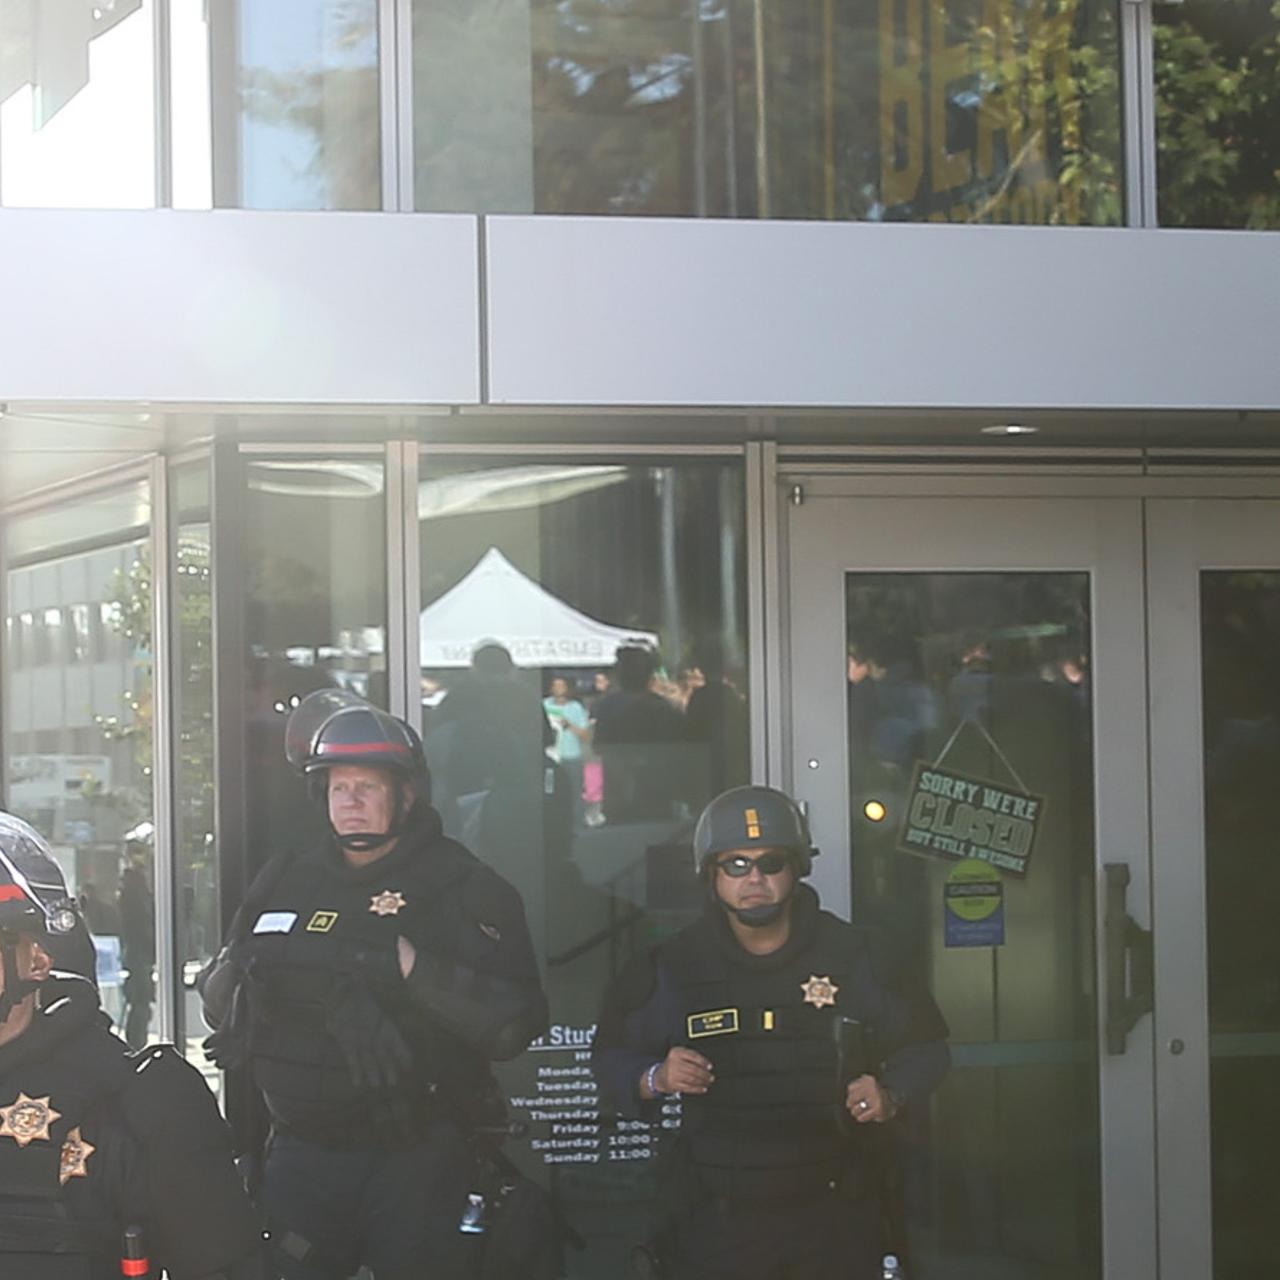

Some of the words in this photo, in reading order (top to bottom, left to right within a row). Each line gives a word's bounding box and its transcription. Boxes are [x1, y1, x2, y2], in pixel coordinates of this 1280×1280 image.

[919, 771, 980, 803] SORRY
[910, 791, 1035, 857] CLOSED
[538, 1066, 594, 1078] Monda
[536, 1081, 598, 1092] Tuesday
[510, 1095, 599, 1107] Wednesday
[530, 1109, 600, 1121] Thursday
[552, 1123, 600, 1134] Friday
[531, 1137, 600, 1150] Saturday
[608, 1134, 651, 1146] 10:00
[544, 1151, 600, 1164] Sunday
[608, 1148, 651, 1160] 11:00
